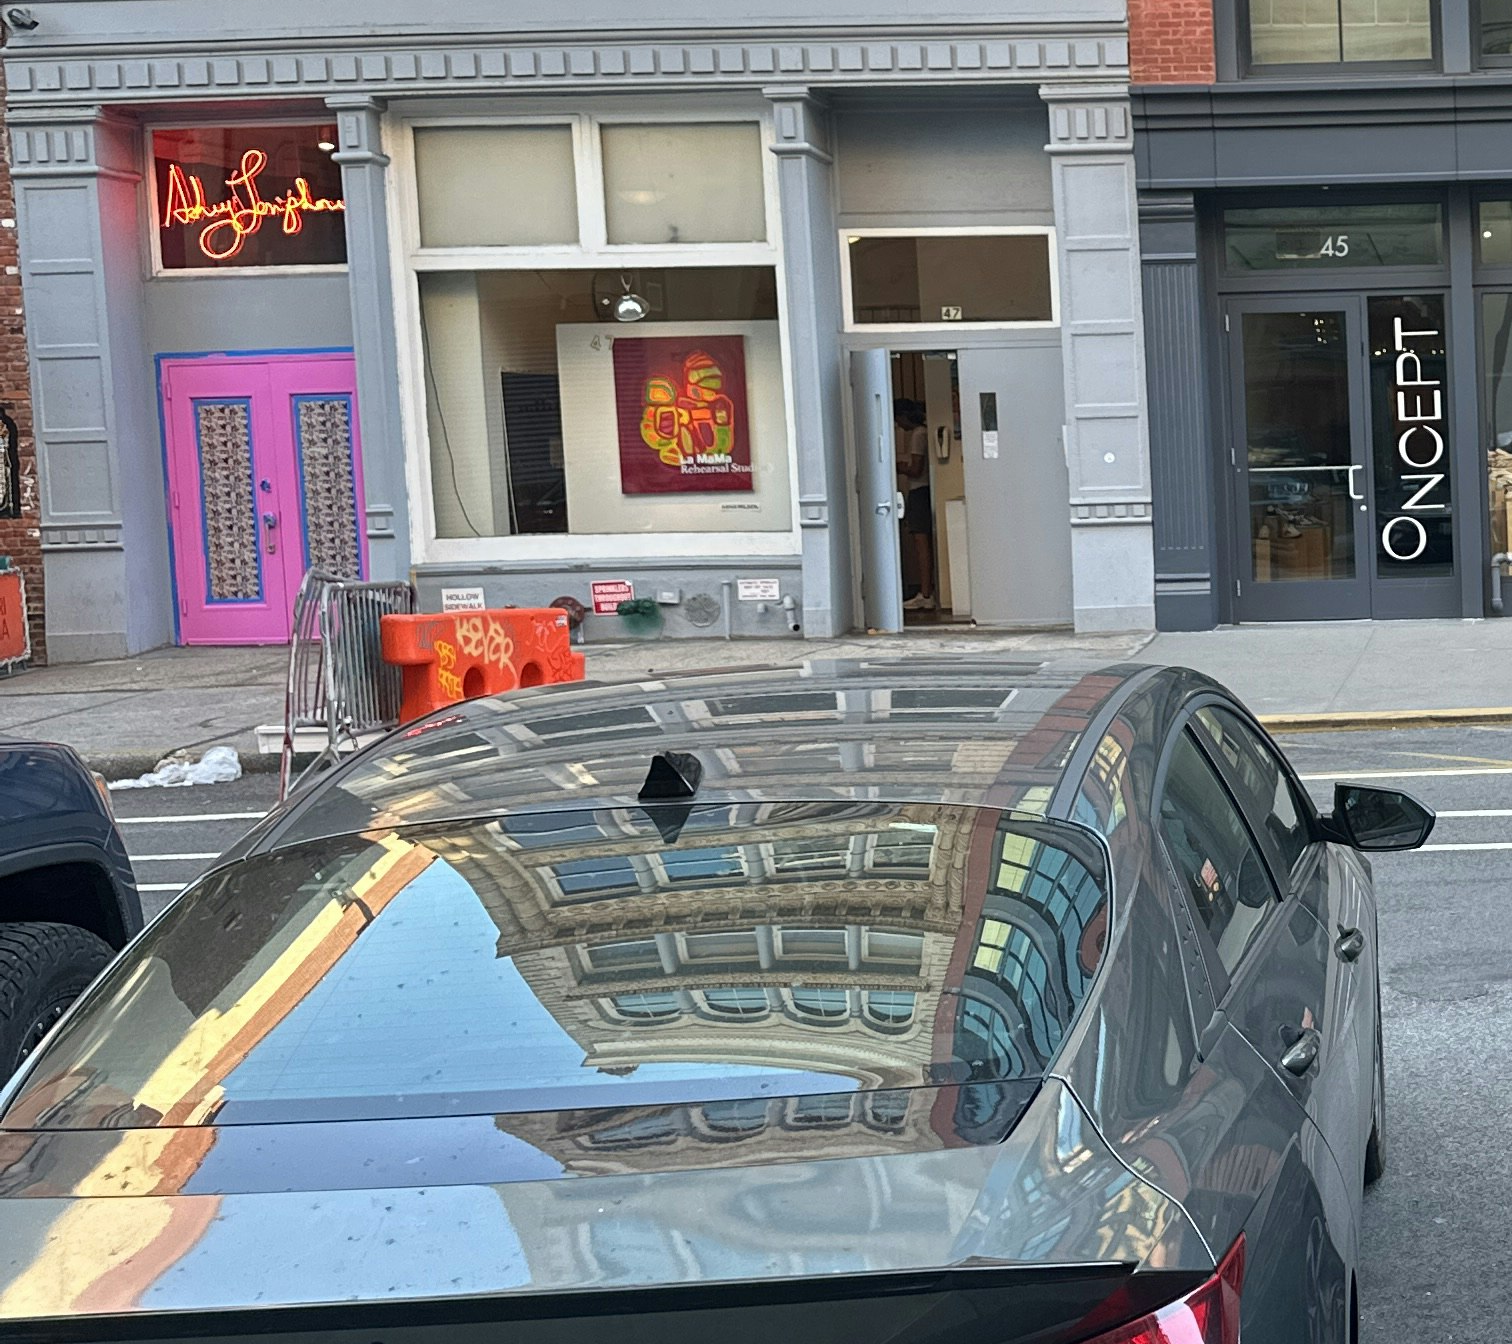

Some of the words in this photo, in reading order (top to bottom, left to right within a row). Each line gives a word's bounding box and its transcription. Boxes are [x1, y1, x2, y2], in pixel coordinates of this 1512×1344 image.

[1320, 235, 1349, 257] 45
[943, 307, 961, 320] 47
[1382, 317, 1444, 560] ONCEPT
[681, 455, 694, 465] La
[697, 453, 732, 464] MaMa
[681, 464, 730, 474] Rehearsal
[446, 593, 479, 601] HOLLOW
